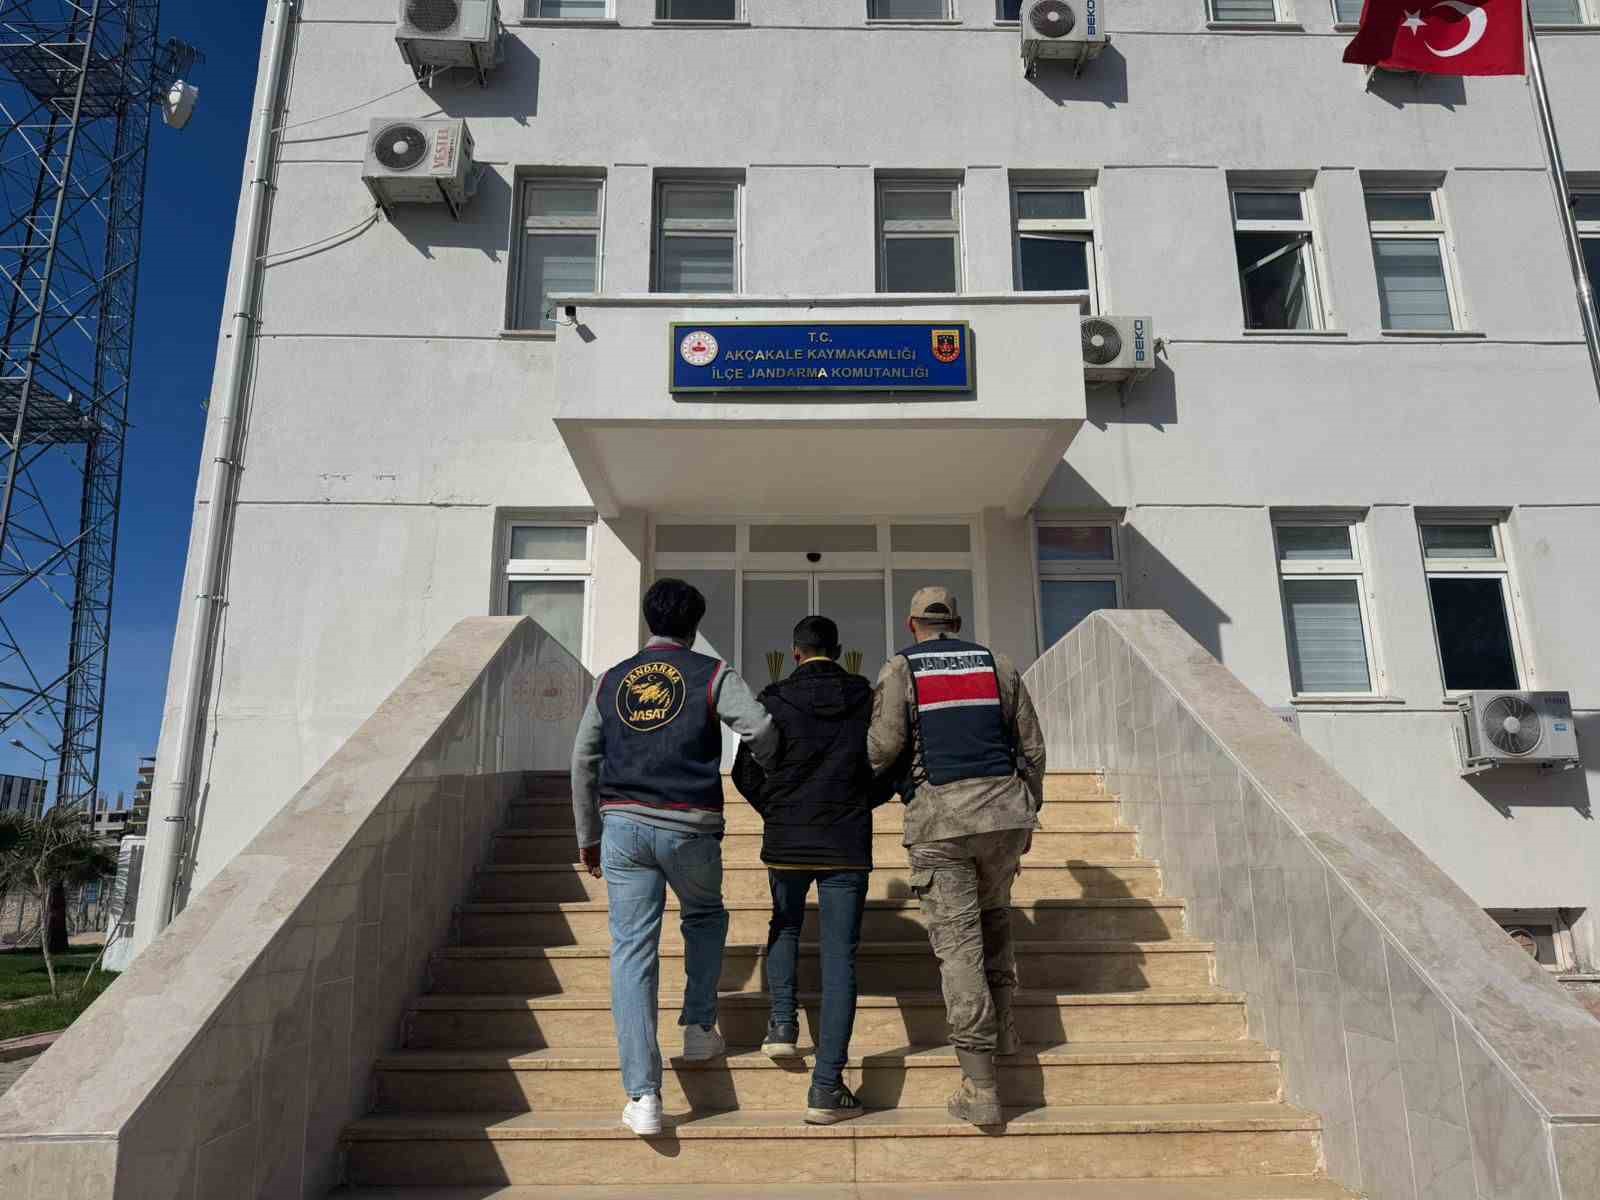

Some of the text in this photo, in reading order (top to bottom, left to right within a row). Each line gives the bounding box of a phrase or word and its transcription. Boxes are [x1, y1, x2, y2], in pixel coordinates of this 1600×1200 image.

[1087, 0, 1096, 35] BEKO
[808, 332, 833, 343] T.C.
[1135, 319, 1144, 361] BEKO
[724, 349, 803, 362] AKÇAKALE
[807, 347, 916, 361] KAYMAKAMLIĞI
[711, 365, 929, 380] İLÇE JANDARMA KOMUTANLIĞI
[920, 655, 985, 671] JANDARMA
[624, 663, 681, 687] JANDARMA
[629, 708, 668, 721] JASAT
